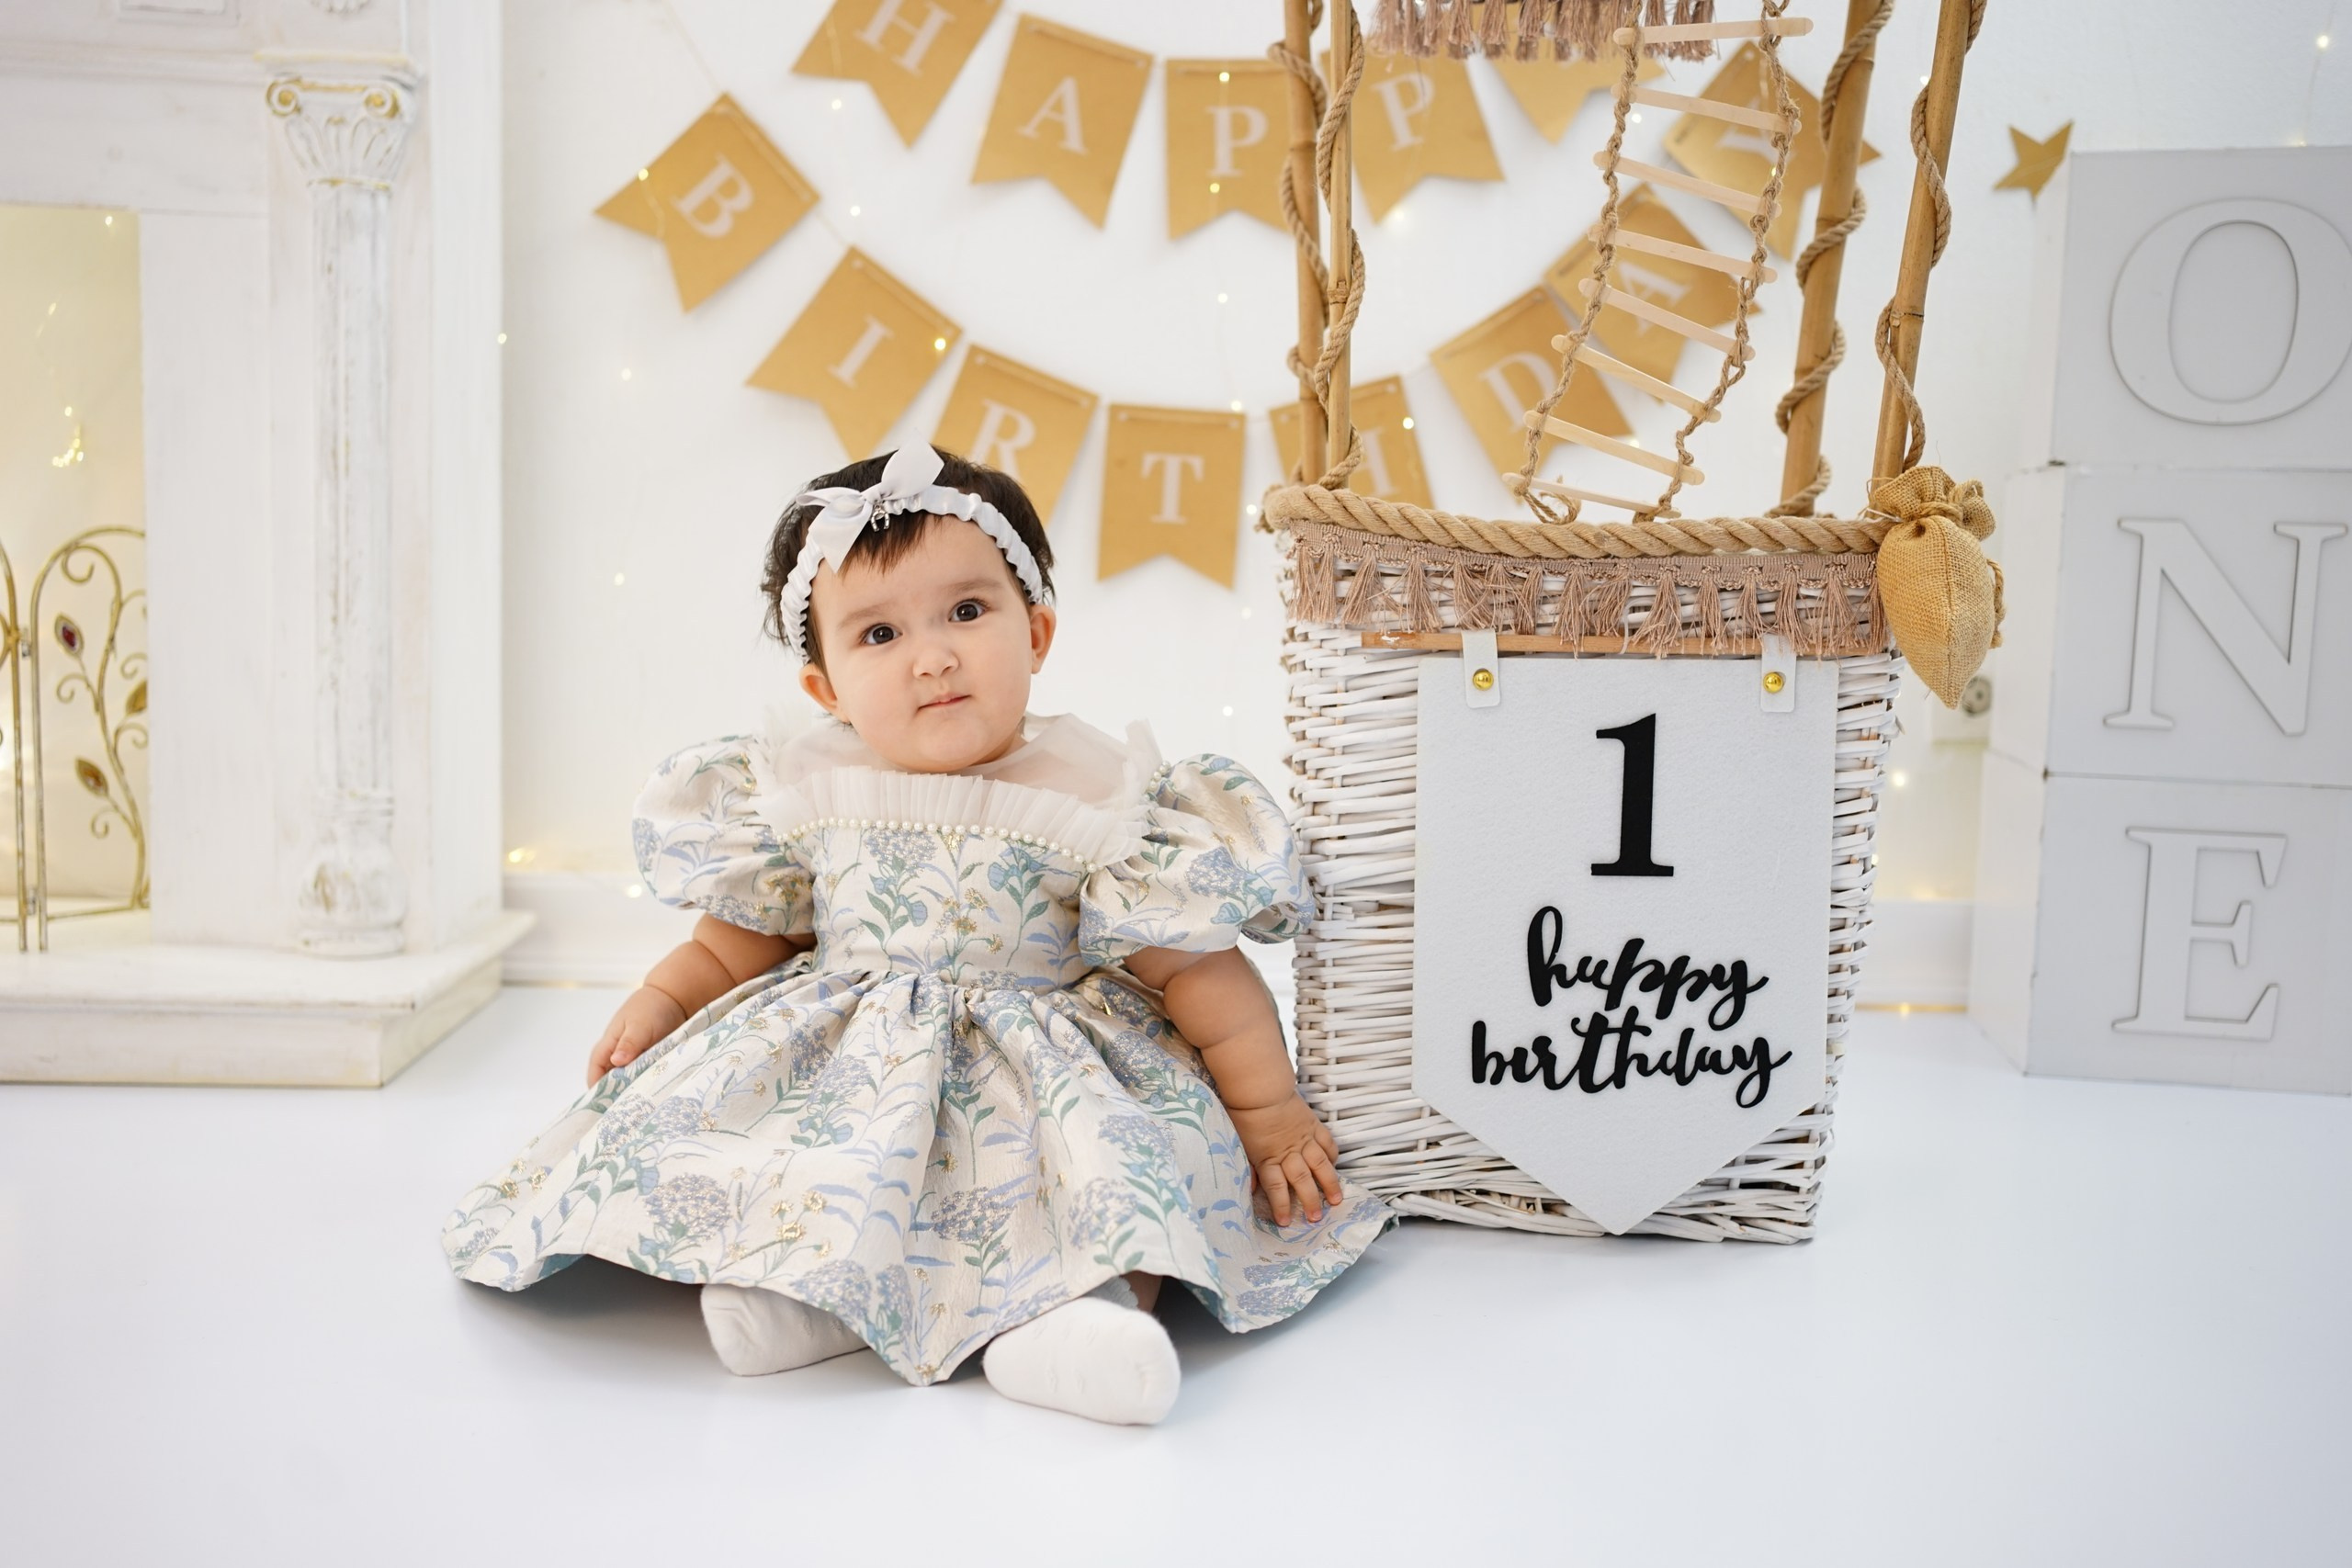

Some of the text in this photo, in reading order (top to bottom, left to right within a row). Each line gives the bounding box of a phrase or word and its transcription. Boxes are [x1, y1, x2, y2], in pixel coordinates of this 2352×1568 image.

[854, 0, 1587, 177] HAPP
[2103, 196, 2352, 1041] ONE
[1591, 713, 1674, 876] 1
[1527, 906, 1770, 1031] happy
[1472, 1006, 1793, 1108] birthday
